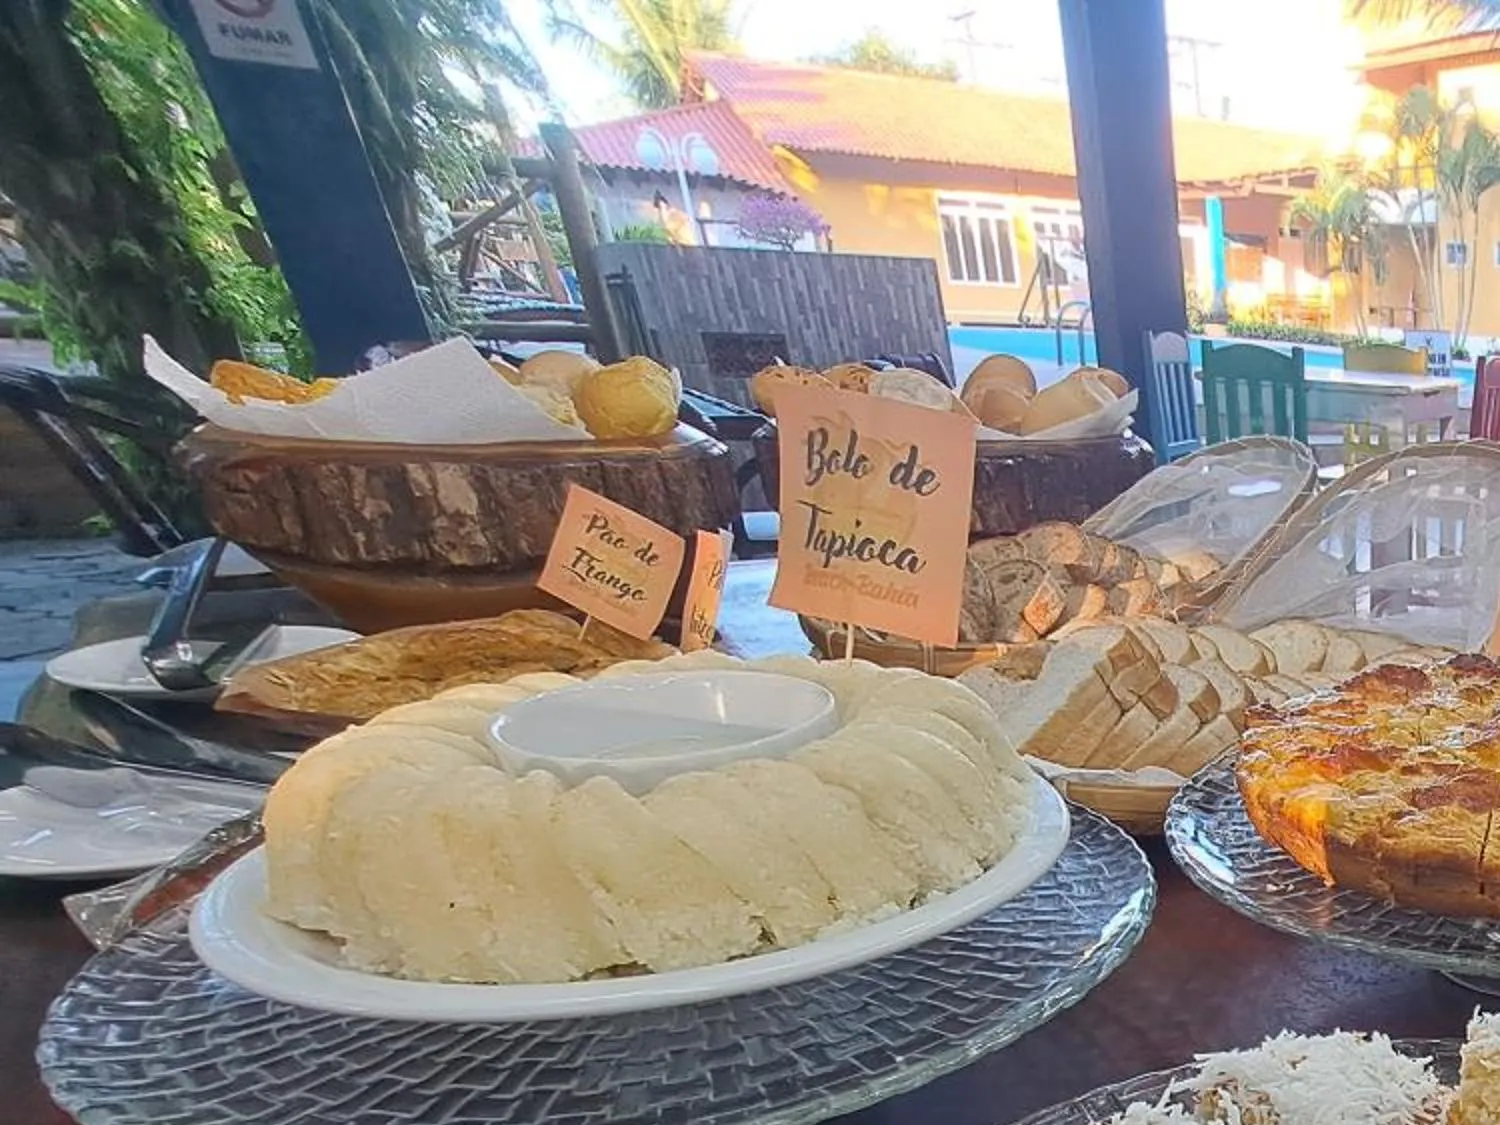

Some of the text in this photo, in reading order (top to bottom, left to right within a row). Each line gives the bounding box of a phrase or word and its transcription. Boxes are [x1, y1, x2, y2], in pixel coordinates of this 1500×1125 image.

[217, 22, 294, 46] FUMAR
[805, 426, 941, 497] Bolo de
[633, 541, 659, 566] de
[796, 500, 926, 574] Tapioca
[560, 546, 648, 599] Frango
